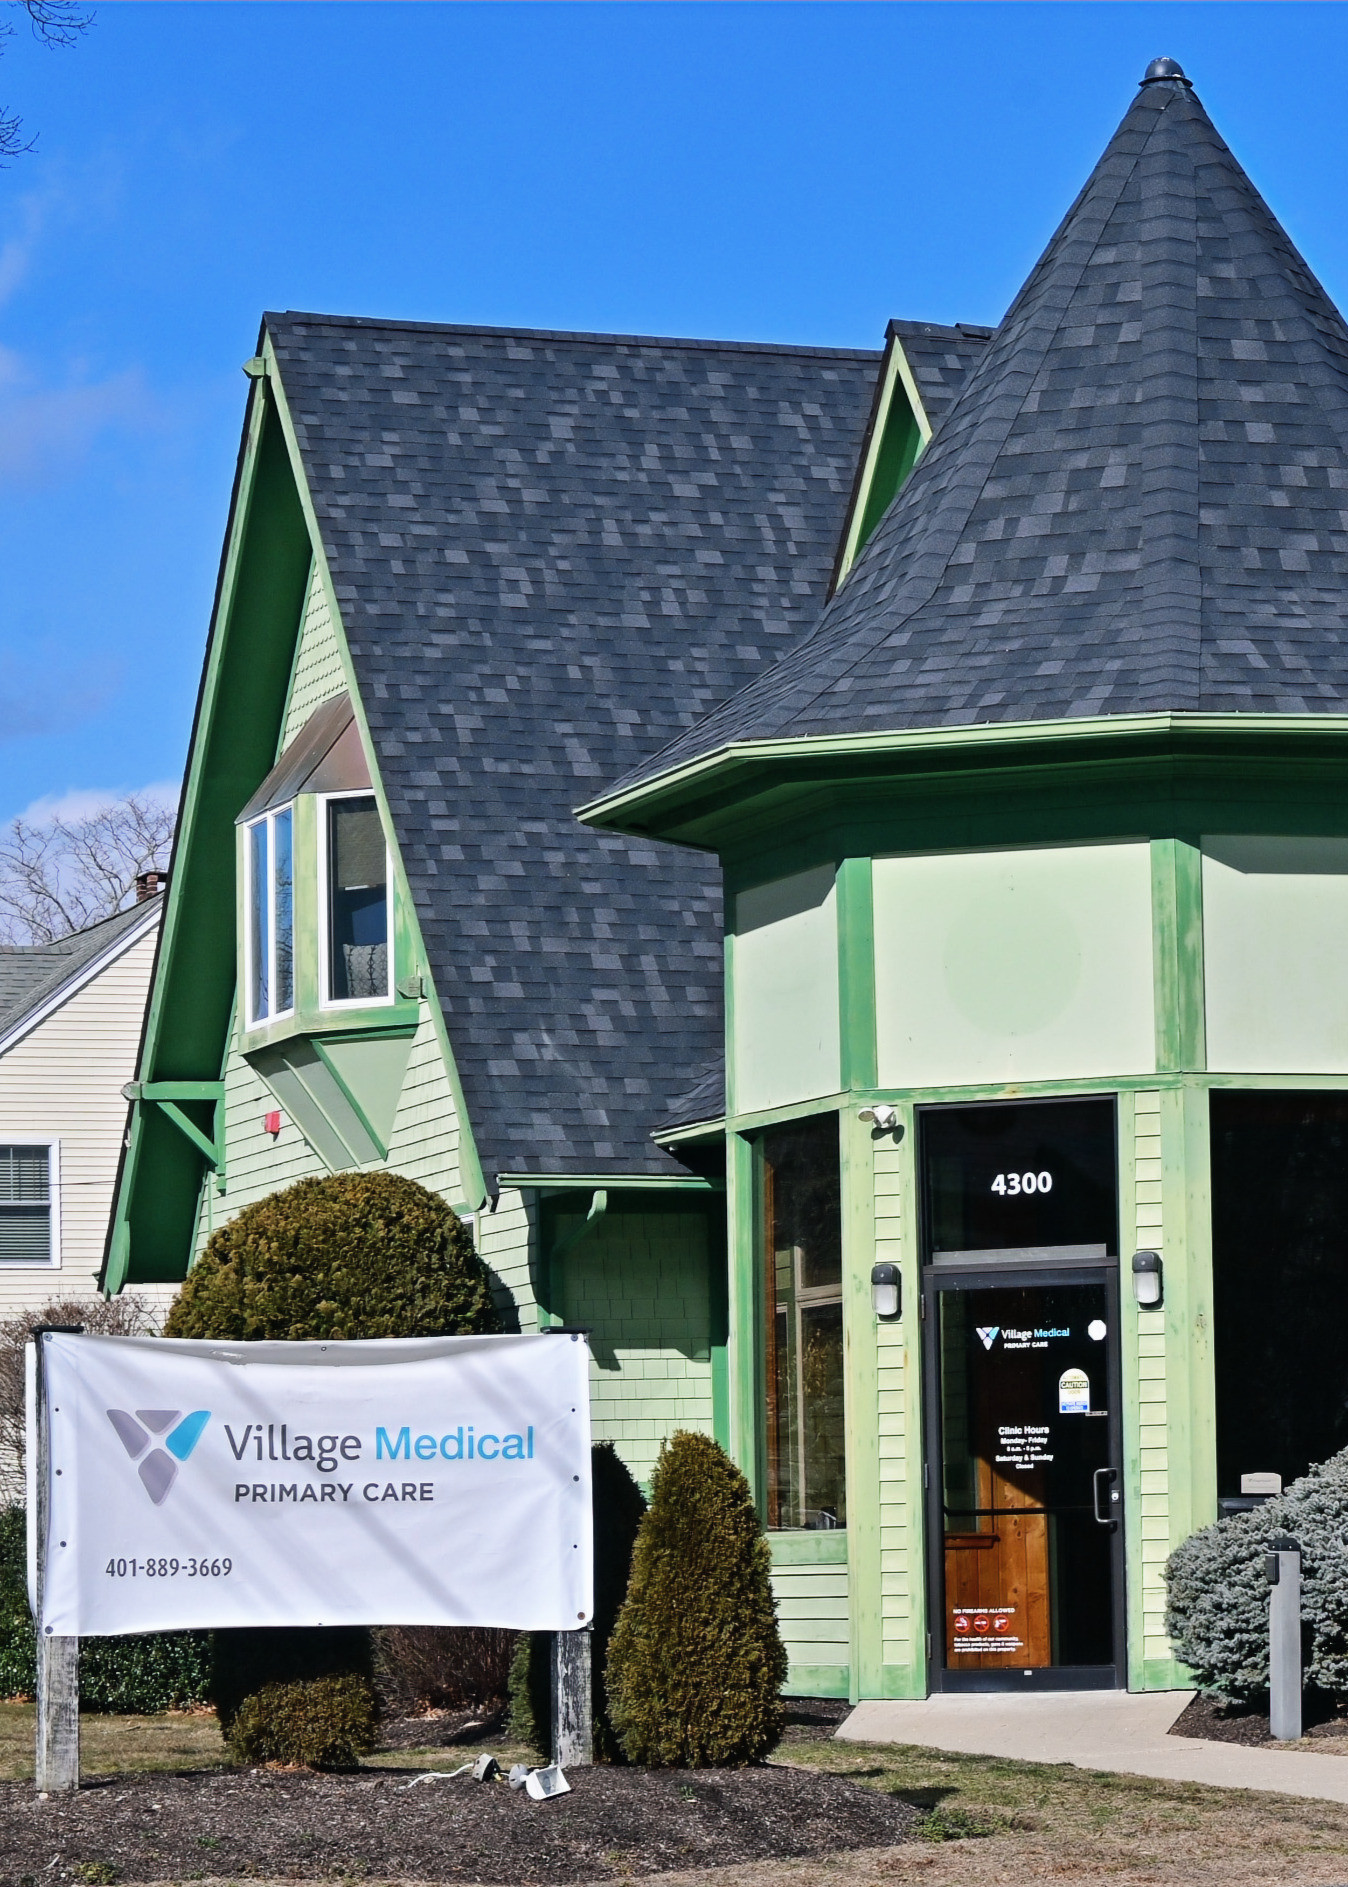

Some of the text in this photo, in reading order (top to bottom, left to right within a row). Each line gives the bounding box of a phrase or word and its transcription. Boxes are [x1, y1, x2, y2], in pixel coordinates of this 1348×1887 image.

[990, 1171, 1053, 1196] 4300
[1001, 1327, 1070, 1341] Village Medical
[1061, 1381, 1088, 1389] CAUTION
[998, 1425, 1050, 1435] Clinic Hours
[224, 1424, 535, 1473] Village Medical
[1027, 1436, 1048, 1444] Friday
[234, 1482, 434, 1503] PRIMARY CARE
[105, 1557, 233, 1578] 401-889-3669
